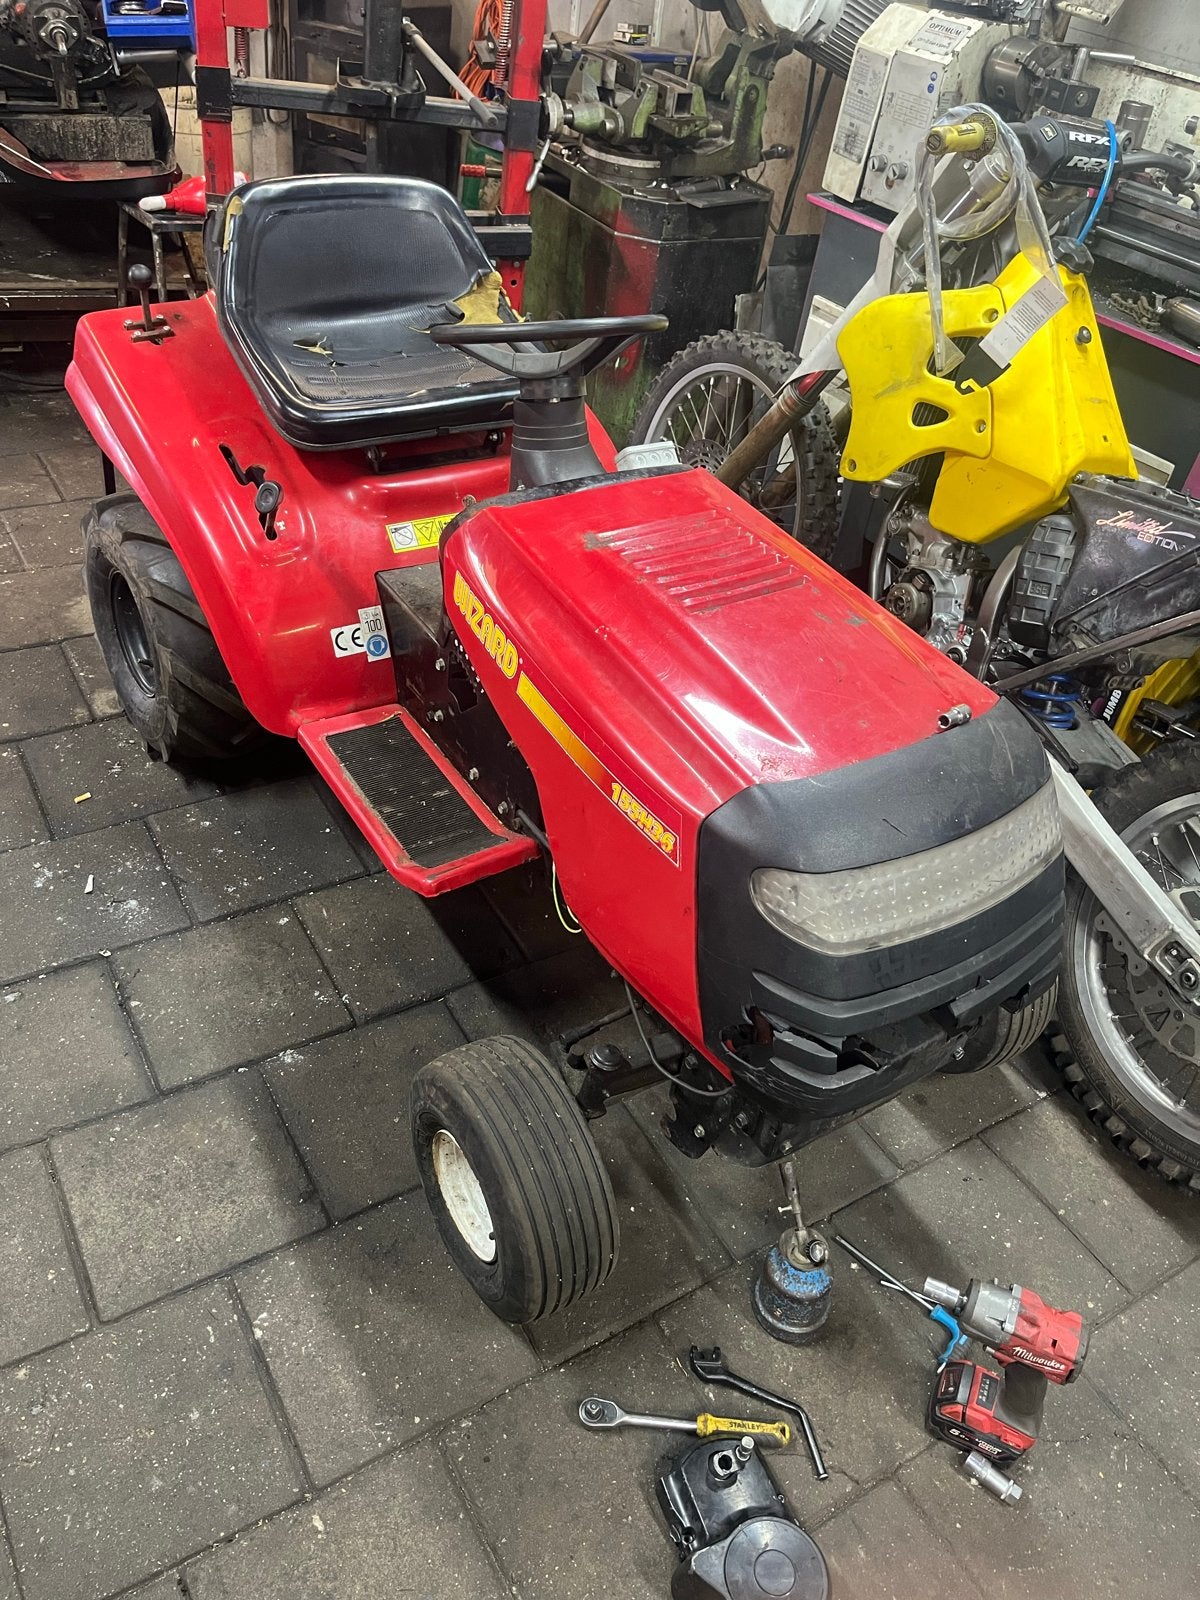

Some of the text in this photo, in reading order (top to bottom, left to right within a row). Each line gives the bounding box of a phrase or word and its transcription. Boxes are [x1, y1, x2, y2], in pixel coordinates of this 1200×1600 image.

[929, 22, 962, 36] OPTIMUM
[1068, 131, 1111, 146] RFX
[1137, 531, 1179, 551] EDITION
[365, 618, 382, 632] 100
[453, 569, 519, 679] WIZARD
[335, 627, 365, 651] CE
[1012, 1346, 1066, 1371] Milwaukee
[729, 1421, 761, 1430] STANLEY
